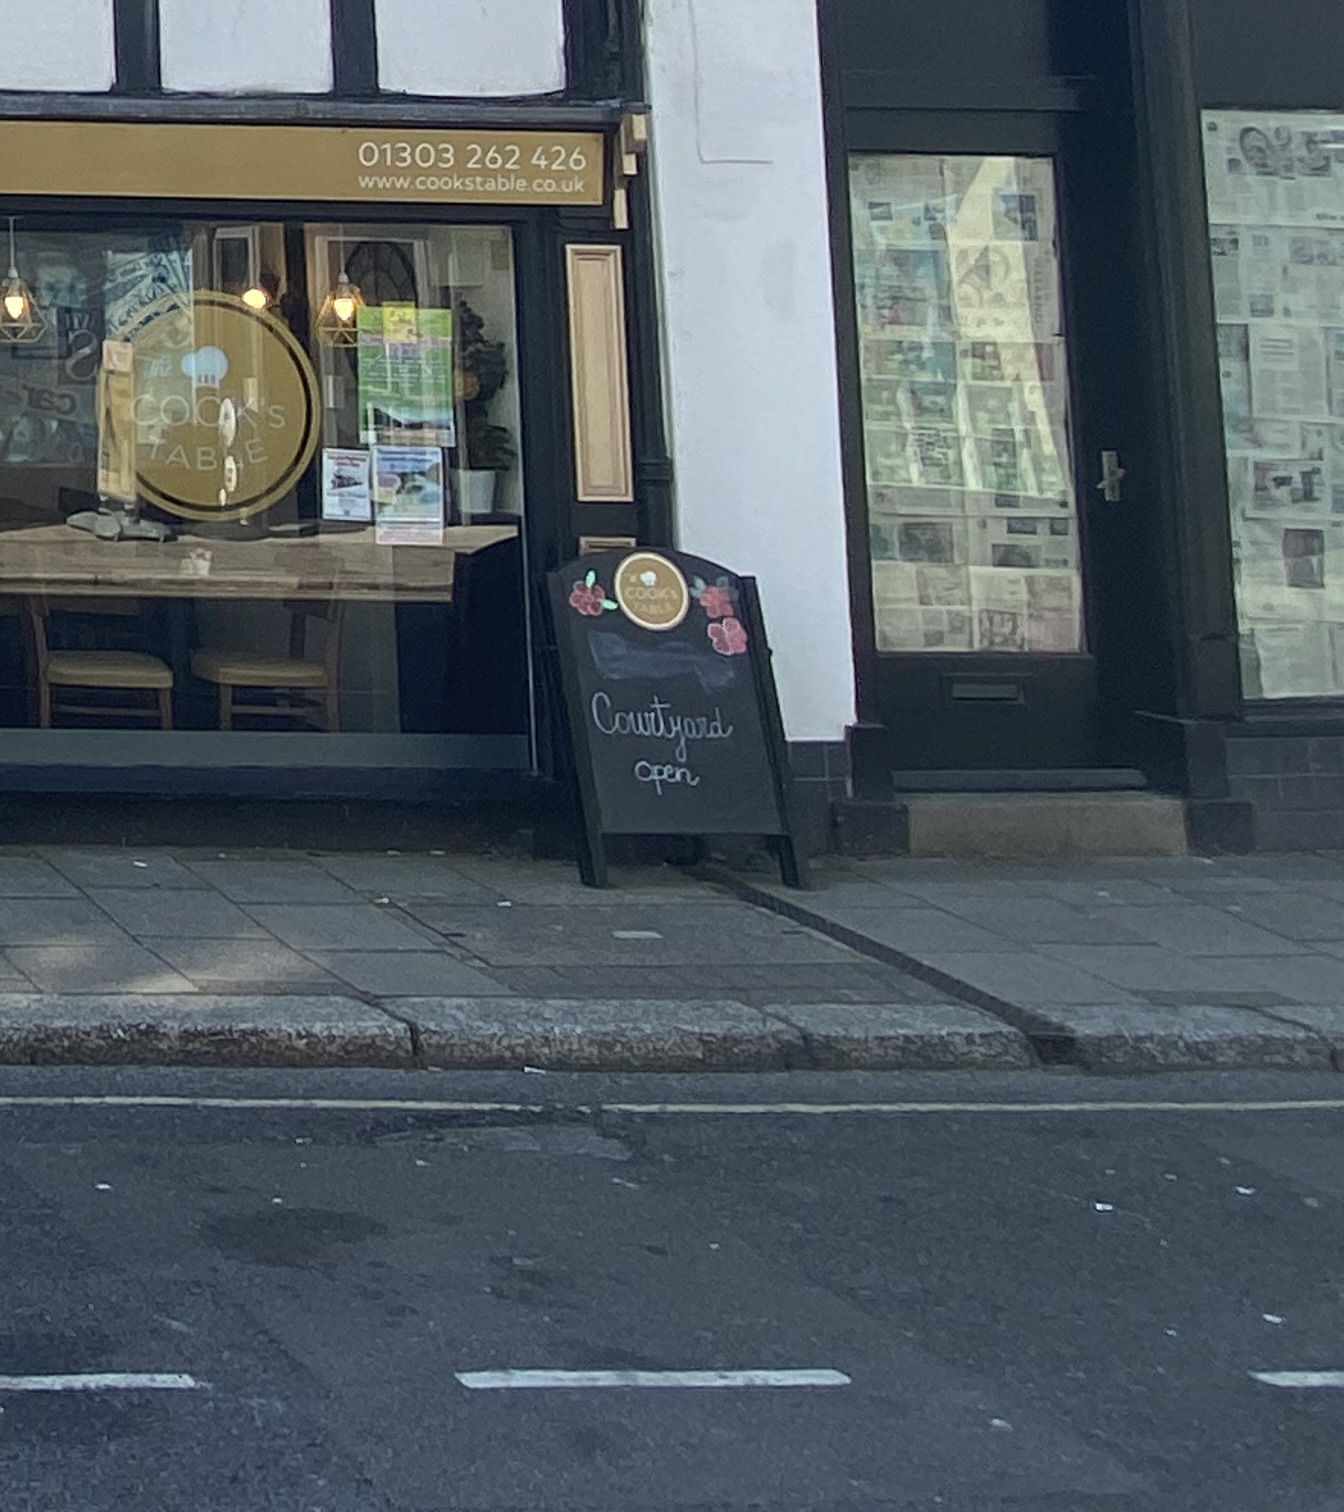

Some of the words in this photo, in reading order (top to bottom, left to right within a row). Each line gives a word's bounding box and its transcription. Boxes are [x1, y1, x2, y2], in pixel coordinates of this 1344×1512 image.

[358, 141, 455, 169] 01303
[465, 144, 522, 170] 262
[530, 145, 587, 171] 426
[358, 172, 586, 194] www.cookstable.co.uk
[591, 691, 734, 763] Courtyard
